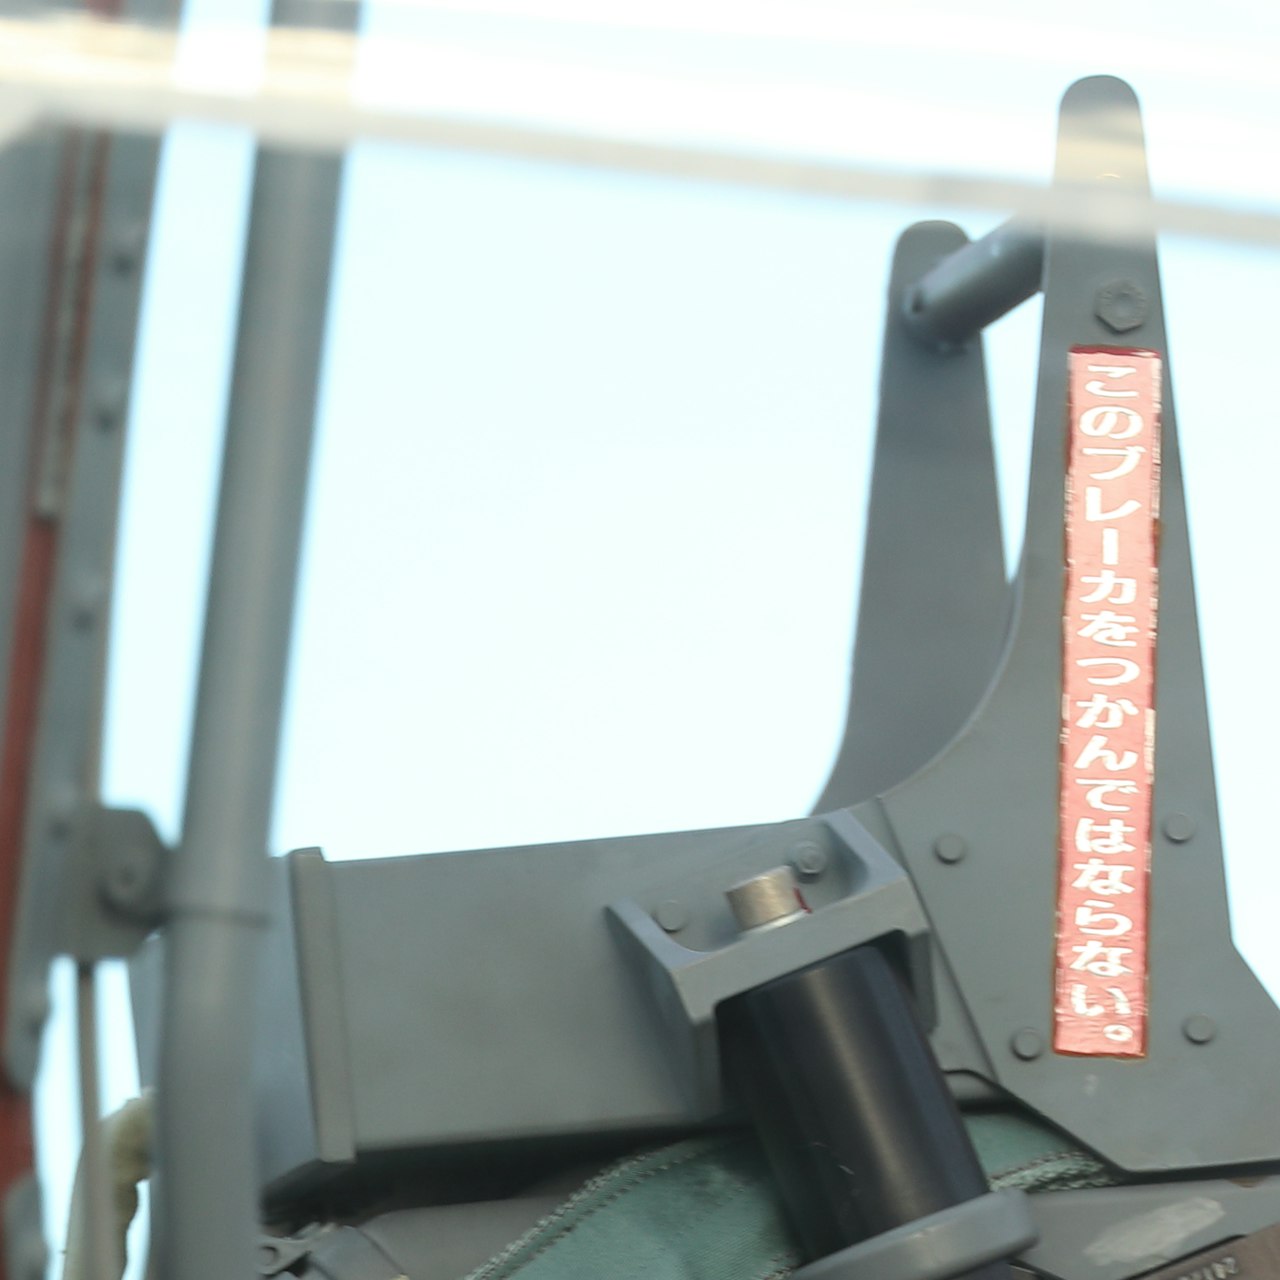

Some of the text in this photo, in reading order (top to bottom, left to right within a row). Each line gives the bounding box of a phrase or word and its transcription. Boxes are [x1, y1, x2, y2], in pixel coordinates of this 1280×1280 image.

[1068, 364, 1145, 1042] このブレーカをつかんではならない。
